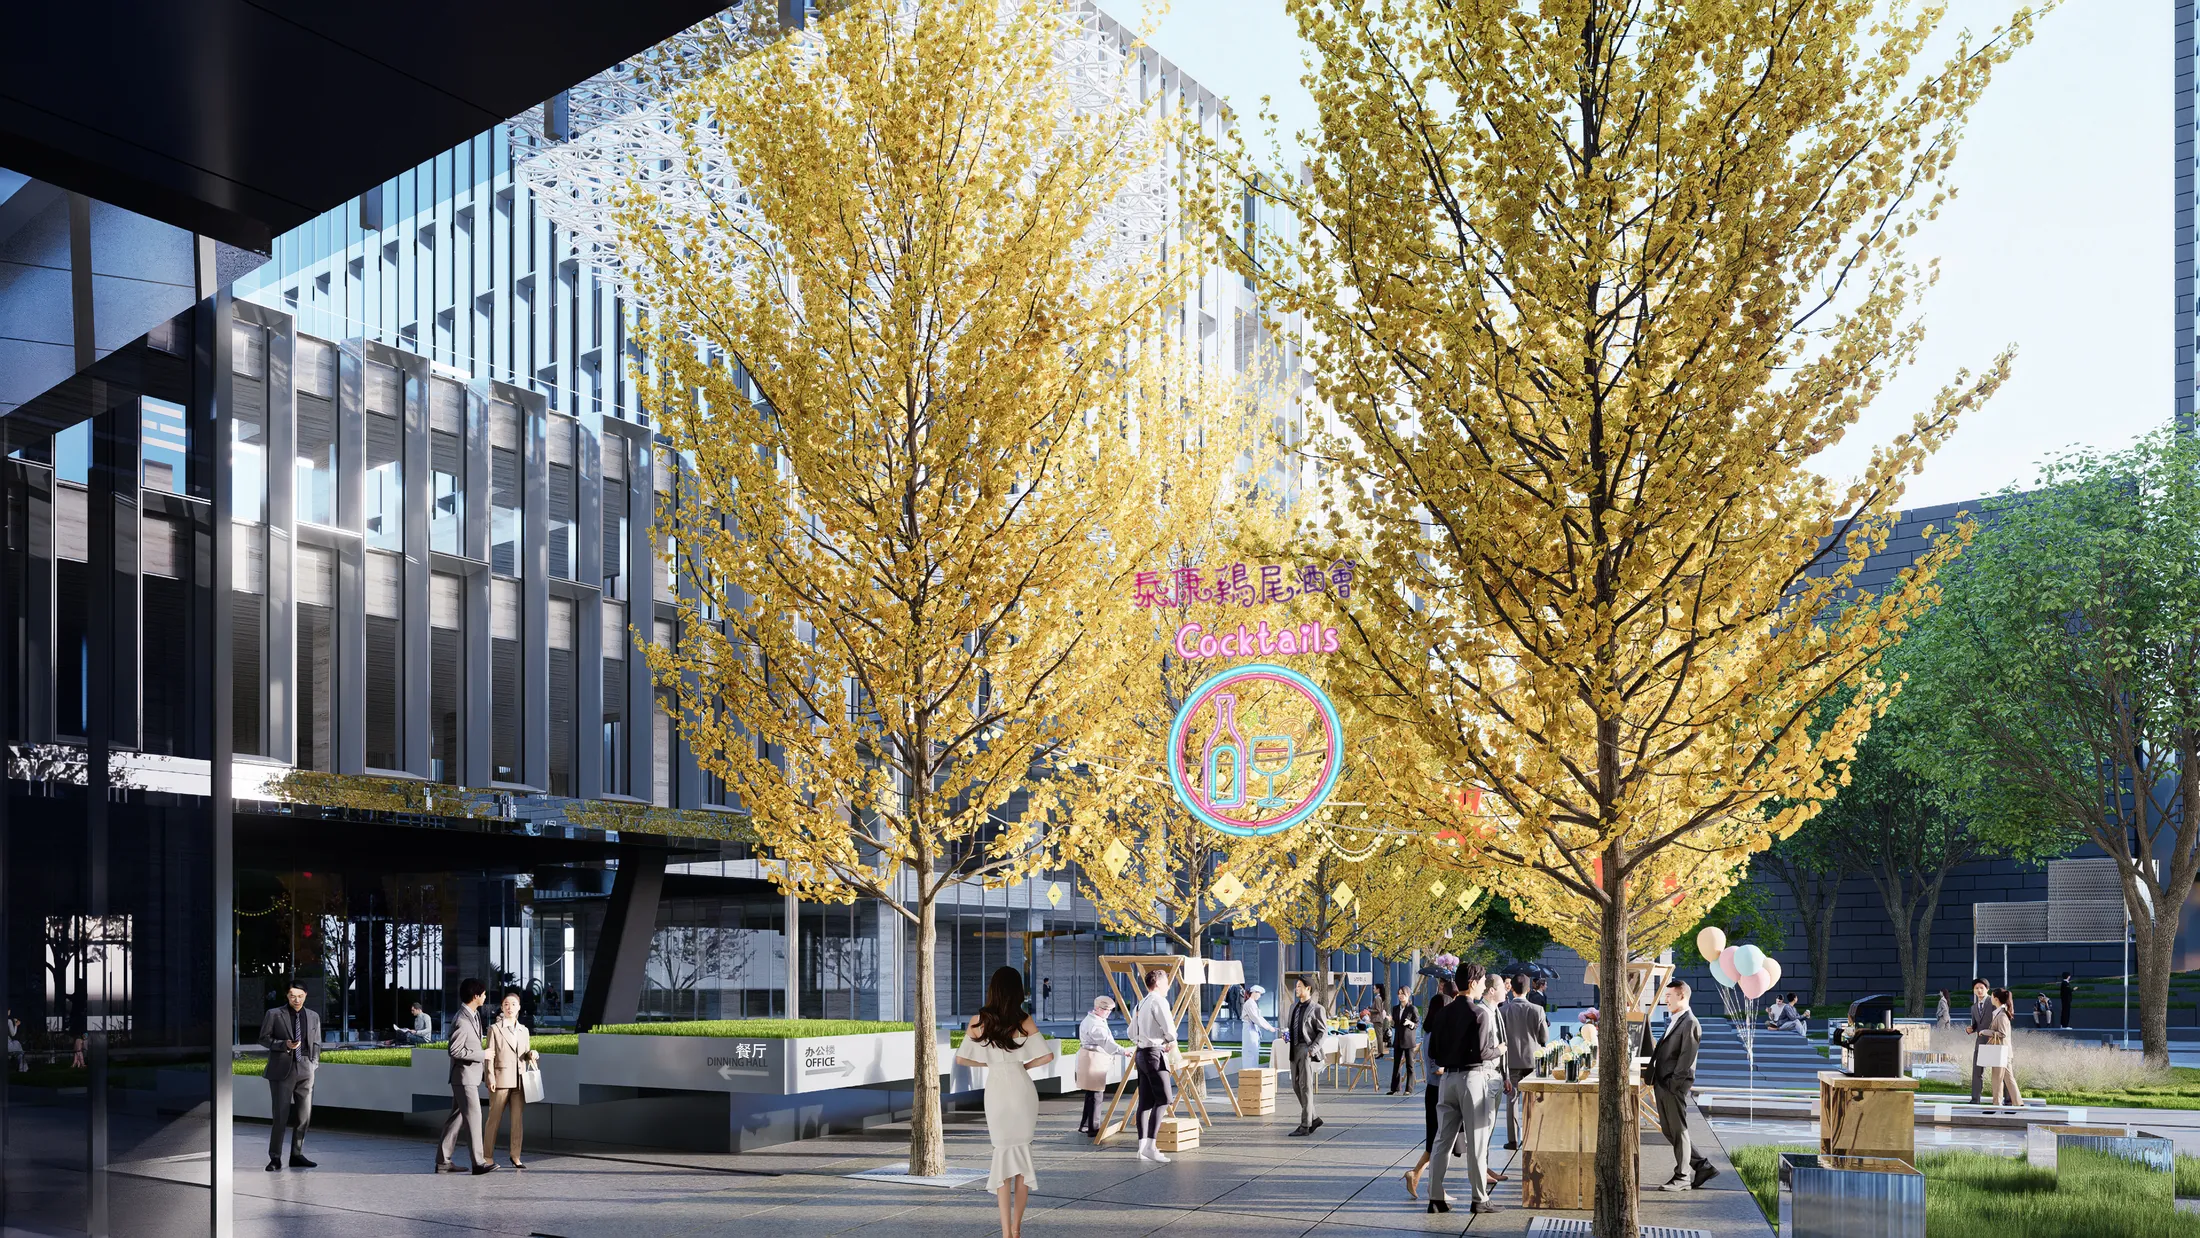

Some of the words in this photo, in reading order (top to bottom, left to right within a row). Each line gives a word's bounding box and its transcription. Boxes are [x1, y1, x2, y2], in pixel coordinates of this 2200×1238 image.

[1175, 620, 1340, 659] Cocktails
[735, 1043, 767, 1059] 餐厅
[805, 1045, 836, 1058] 办公楼
[707, 1057, 745, 1068] DINNING
[747, 1057, 768, 1068] HALL
[805, 1057, 836, 1068] OFFICE
